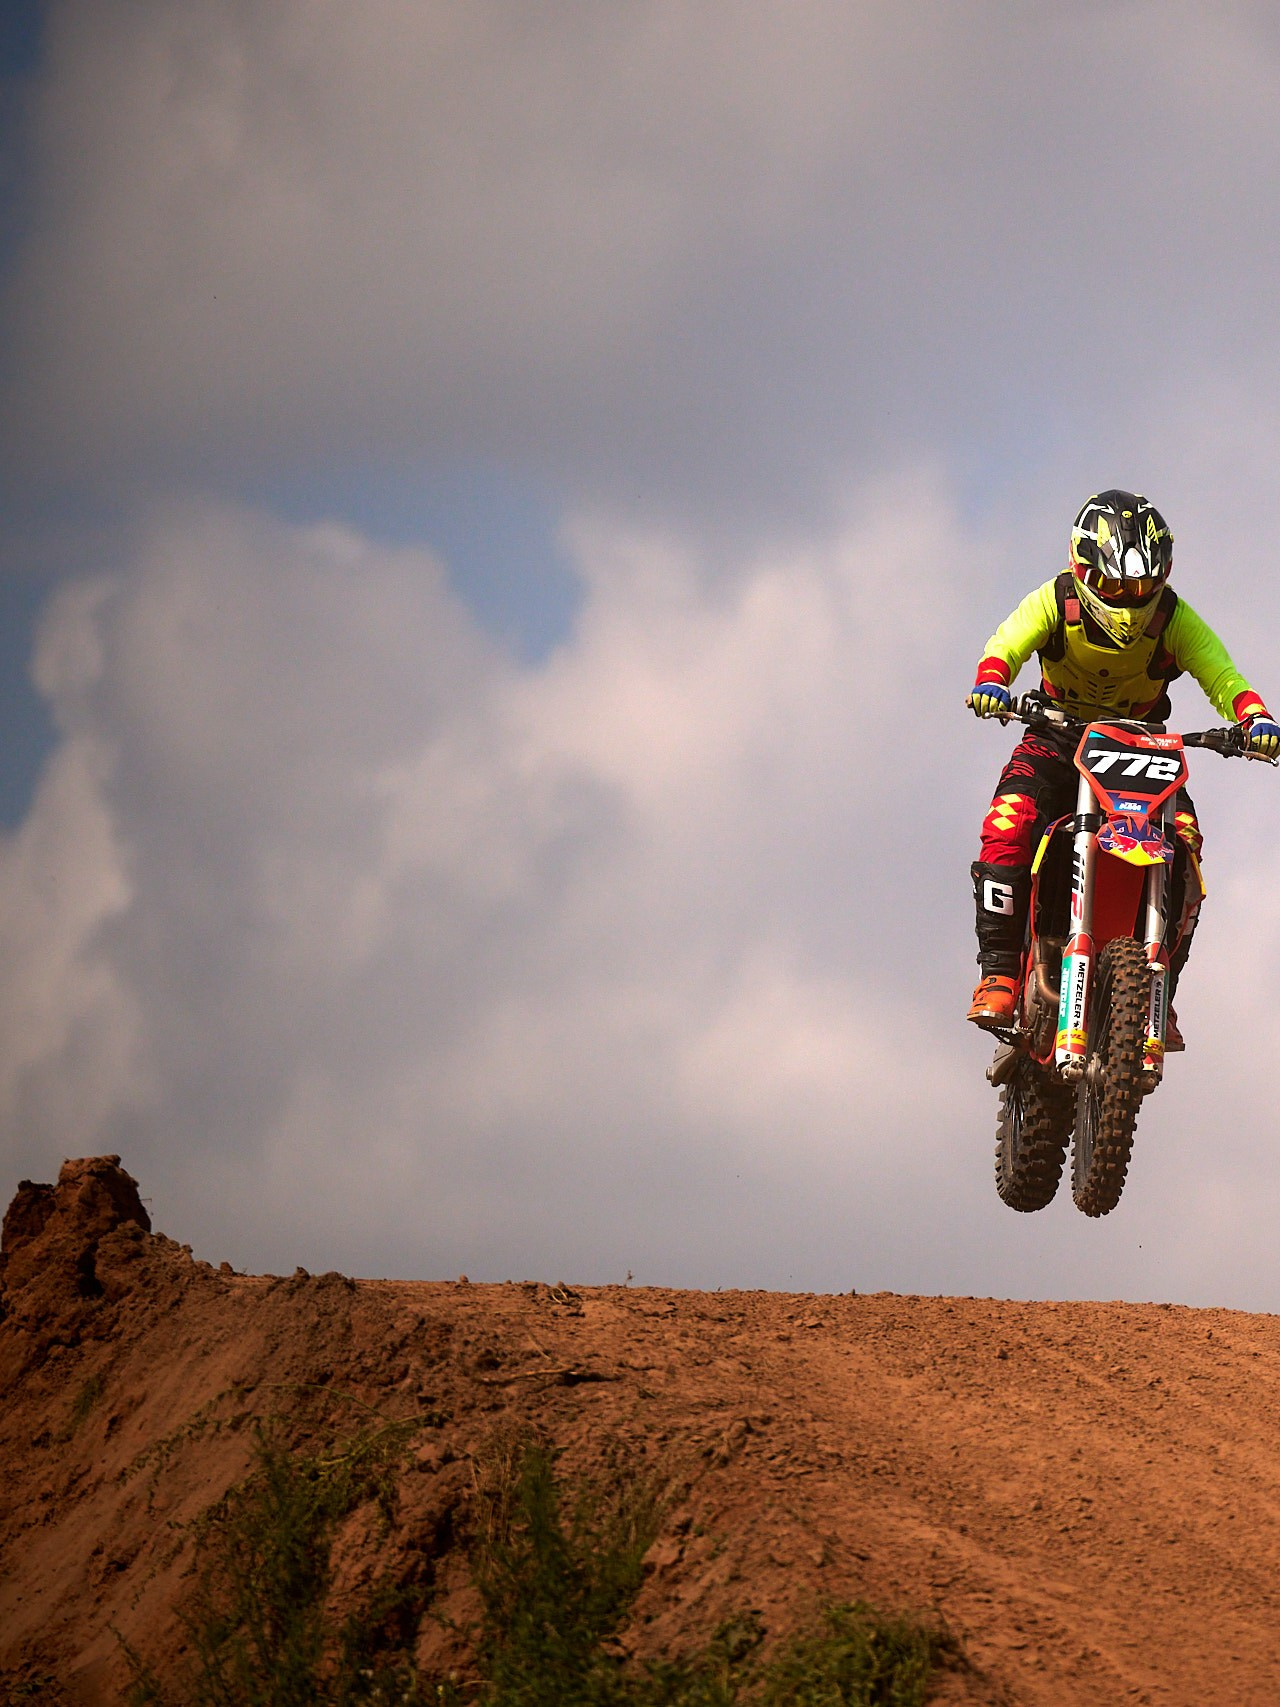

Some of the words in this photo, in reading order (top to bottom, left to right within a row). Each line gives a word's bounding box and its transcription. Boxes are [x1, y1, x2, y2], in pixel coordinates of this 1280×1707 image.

[1087, 749, 1181, 781] 772
[983, 879, 1014, 916] G
[1073, 961, 1086, 1019] METZELER
[1153, 988, 1162, 1038] METZELER
